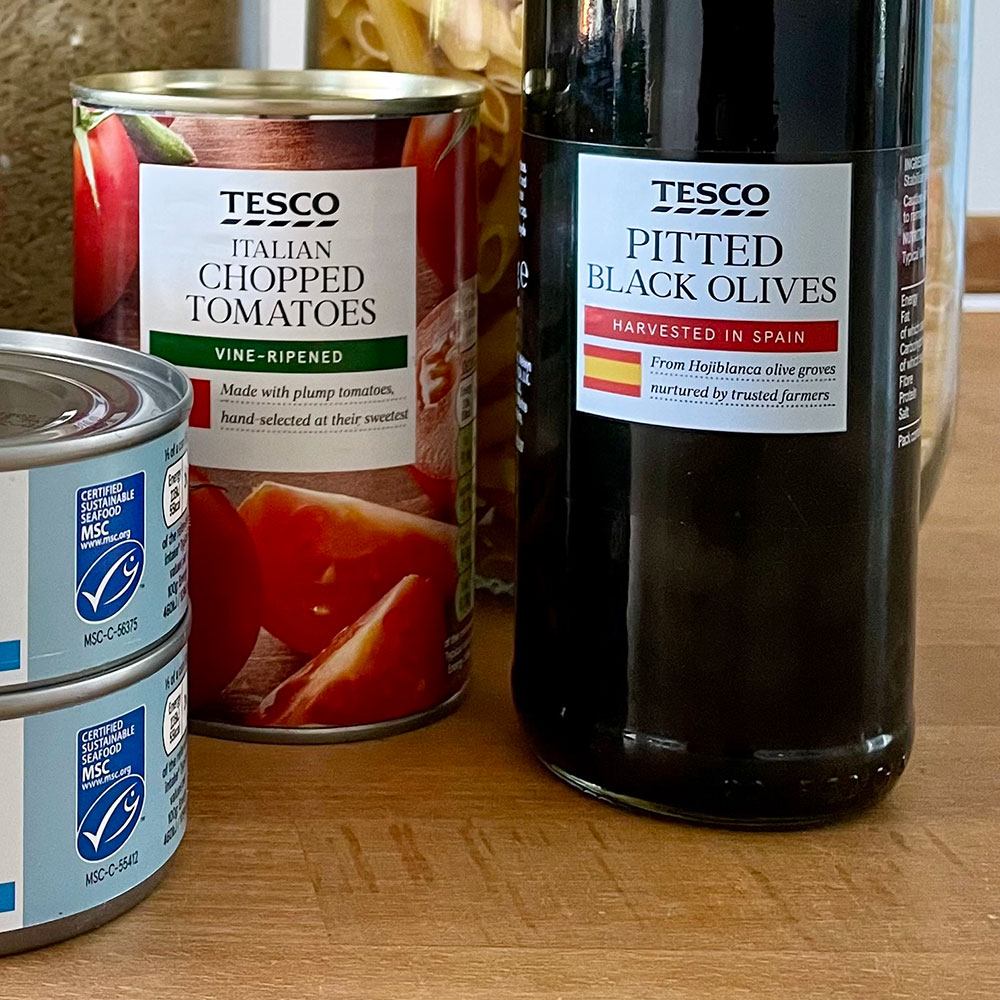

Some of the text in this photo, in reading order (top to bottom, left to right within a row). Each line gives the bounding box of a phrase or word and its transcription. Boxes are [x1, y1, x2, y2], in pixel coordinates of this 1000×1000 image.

[220, 190, 340, 216] TESCO
[651, 180, 770, 206] TESCO
[231, 238, 332, 260] ITALIAN
[626, 227, 783, 268] PITTED
[198, 262, 365, 293] CHOPPED
[587, 263, 838, 305] BLACK OLIVES
[185, 294, 377, 327] TOMATOES
[613, 318, 805, 344] HARVESTED IN SPAIN
[214, 347, 343, 365] VINE-RIPENED
[650, 355, 837, 380] From Hojiblanca olive groves
[220, 383, 395, 402] Made with plump tomatoes,
[650, 383, 830, 404] nurtured by trusted farmers
[220, 409, 409, 428] hand-selected at their sweetest
[80, 482, 123, 502] CERTIFIED
[80, 489, 135, 513] SUSTAINABLE
[80, 505, 122, 525] SEAFOOD
[80, 520, 110, 542] MSC
[80, 529, 131, 550] www.msc.org
[82, 719, 124, 742] CERTIFIED
[82, 724, 135, 754] SUSTAINABLE
[82, 742, 122, 765] SEAFOOD
[81, 765, 132, 791] www.msc.org
[82, 759, 111, 783] MSC
